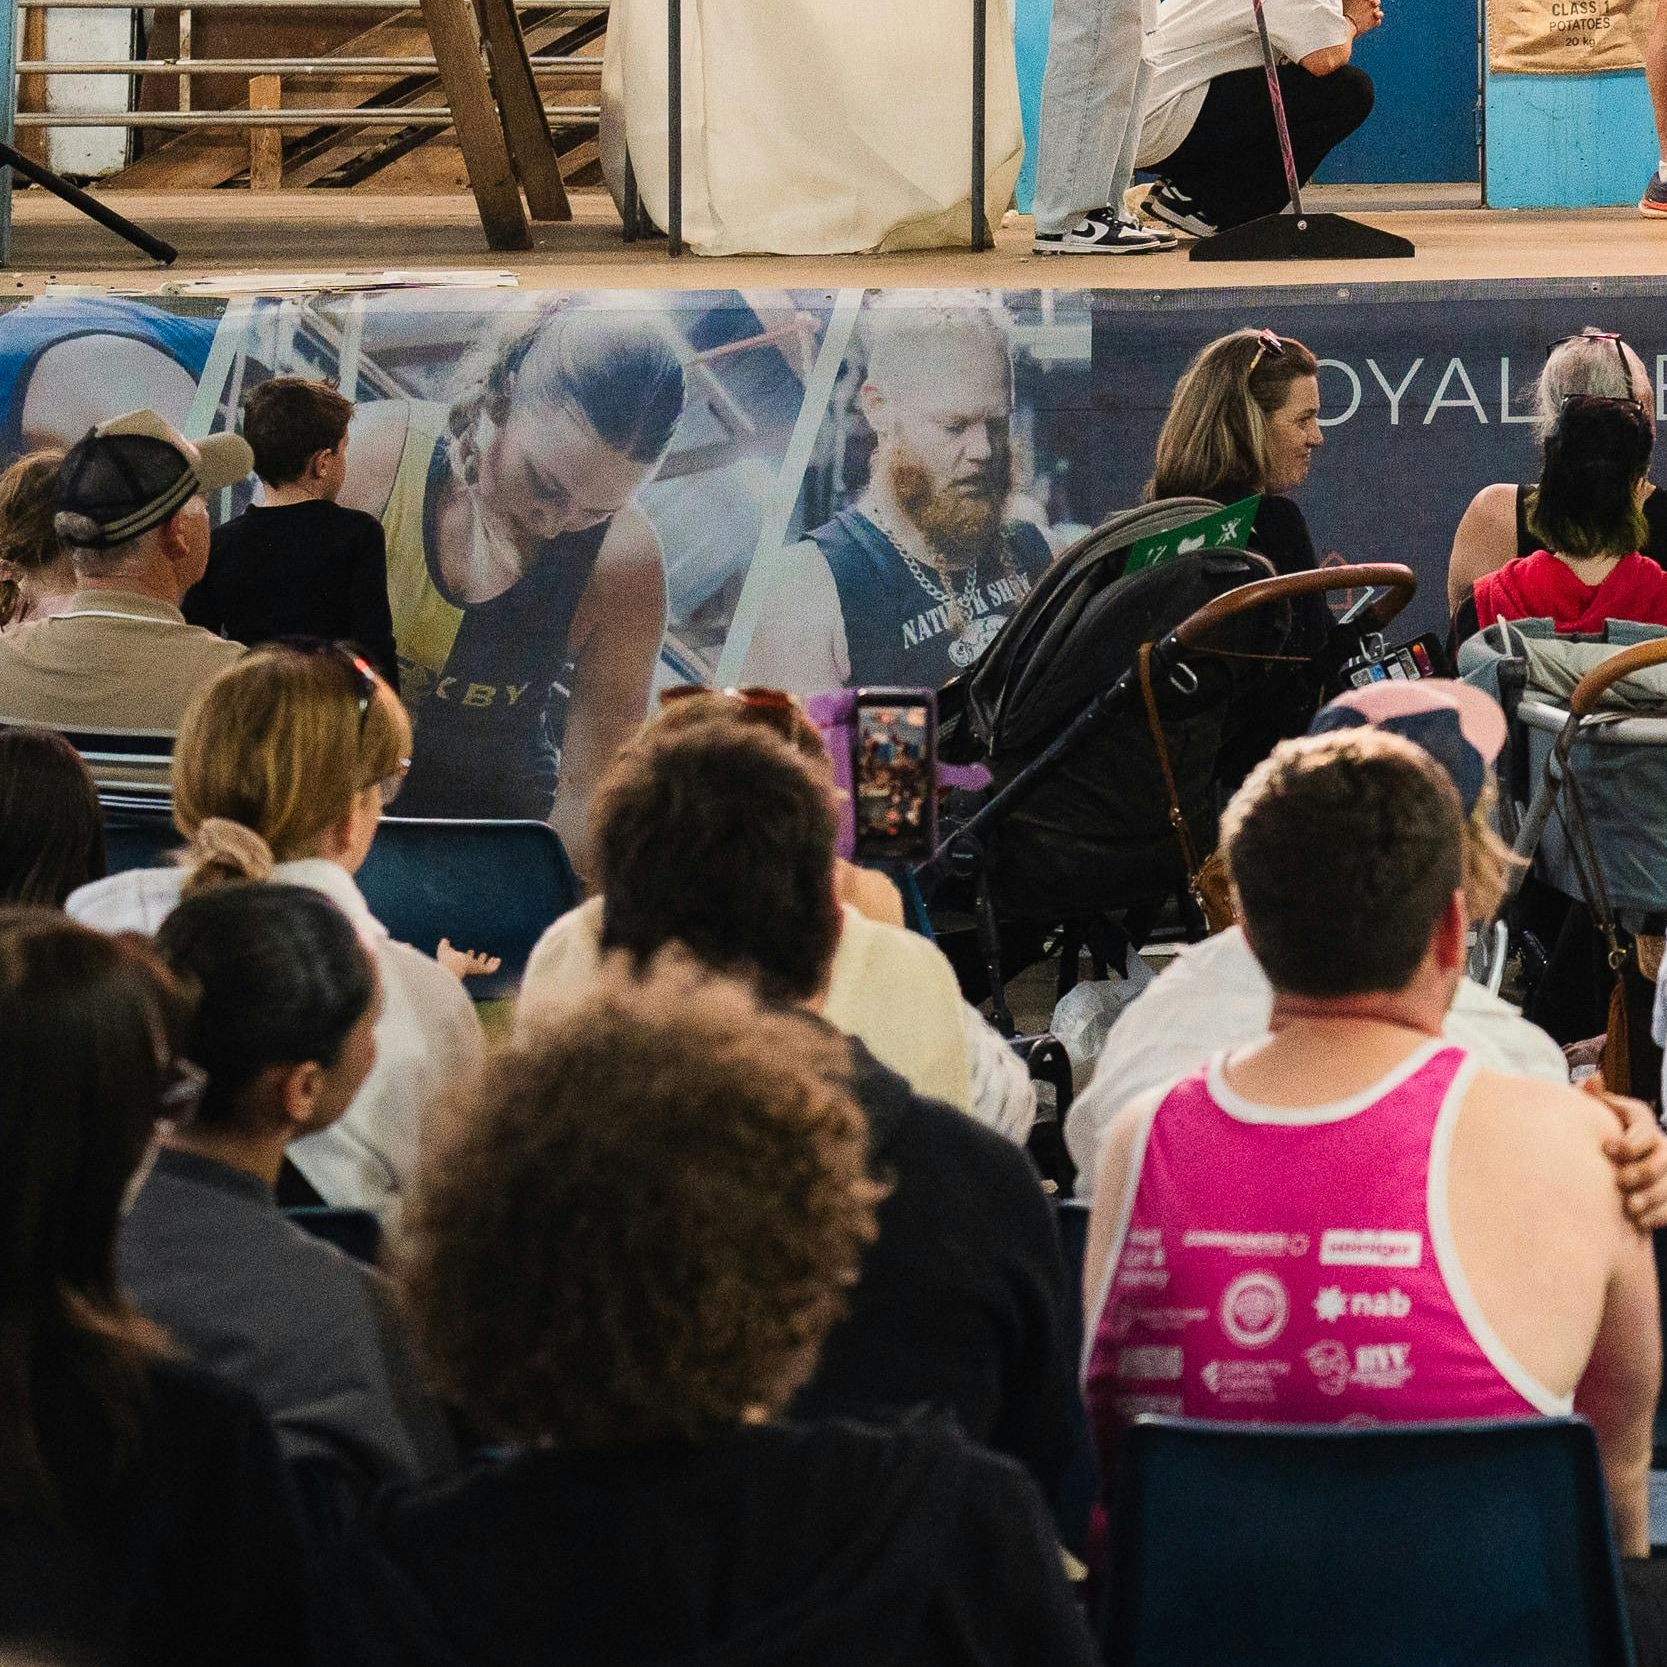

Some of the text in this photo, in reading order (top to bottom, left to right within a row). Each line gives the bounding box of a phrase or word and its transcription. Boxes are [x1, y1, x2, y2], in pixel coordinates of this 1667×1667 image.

[1551, 0, 1610, 16] CLASS 1
[1549, 17, 1611, 32] POTATOES
[1565, 37, 1596, 48] 20 kg
[1313, 356, 1540, 427] OYAL
[1350, 1288, 1412, 1319] nab
